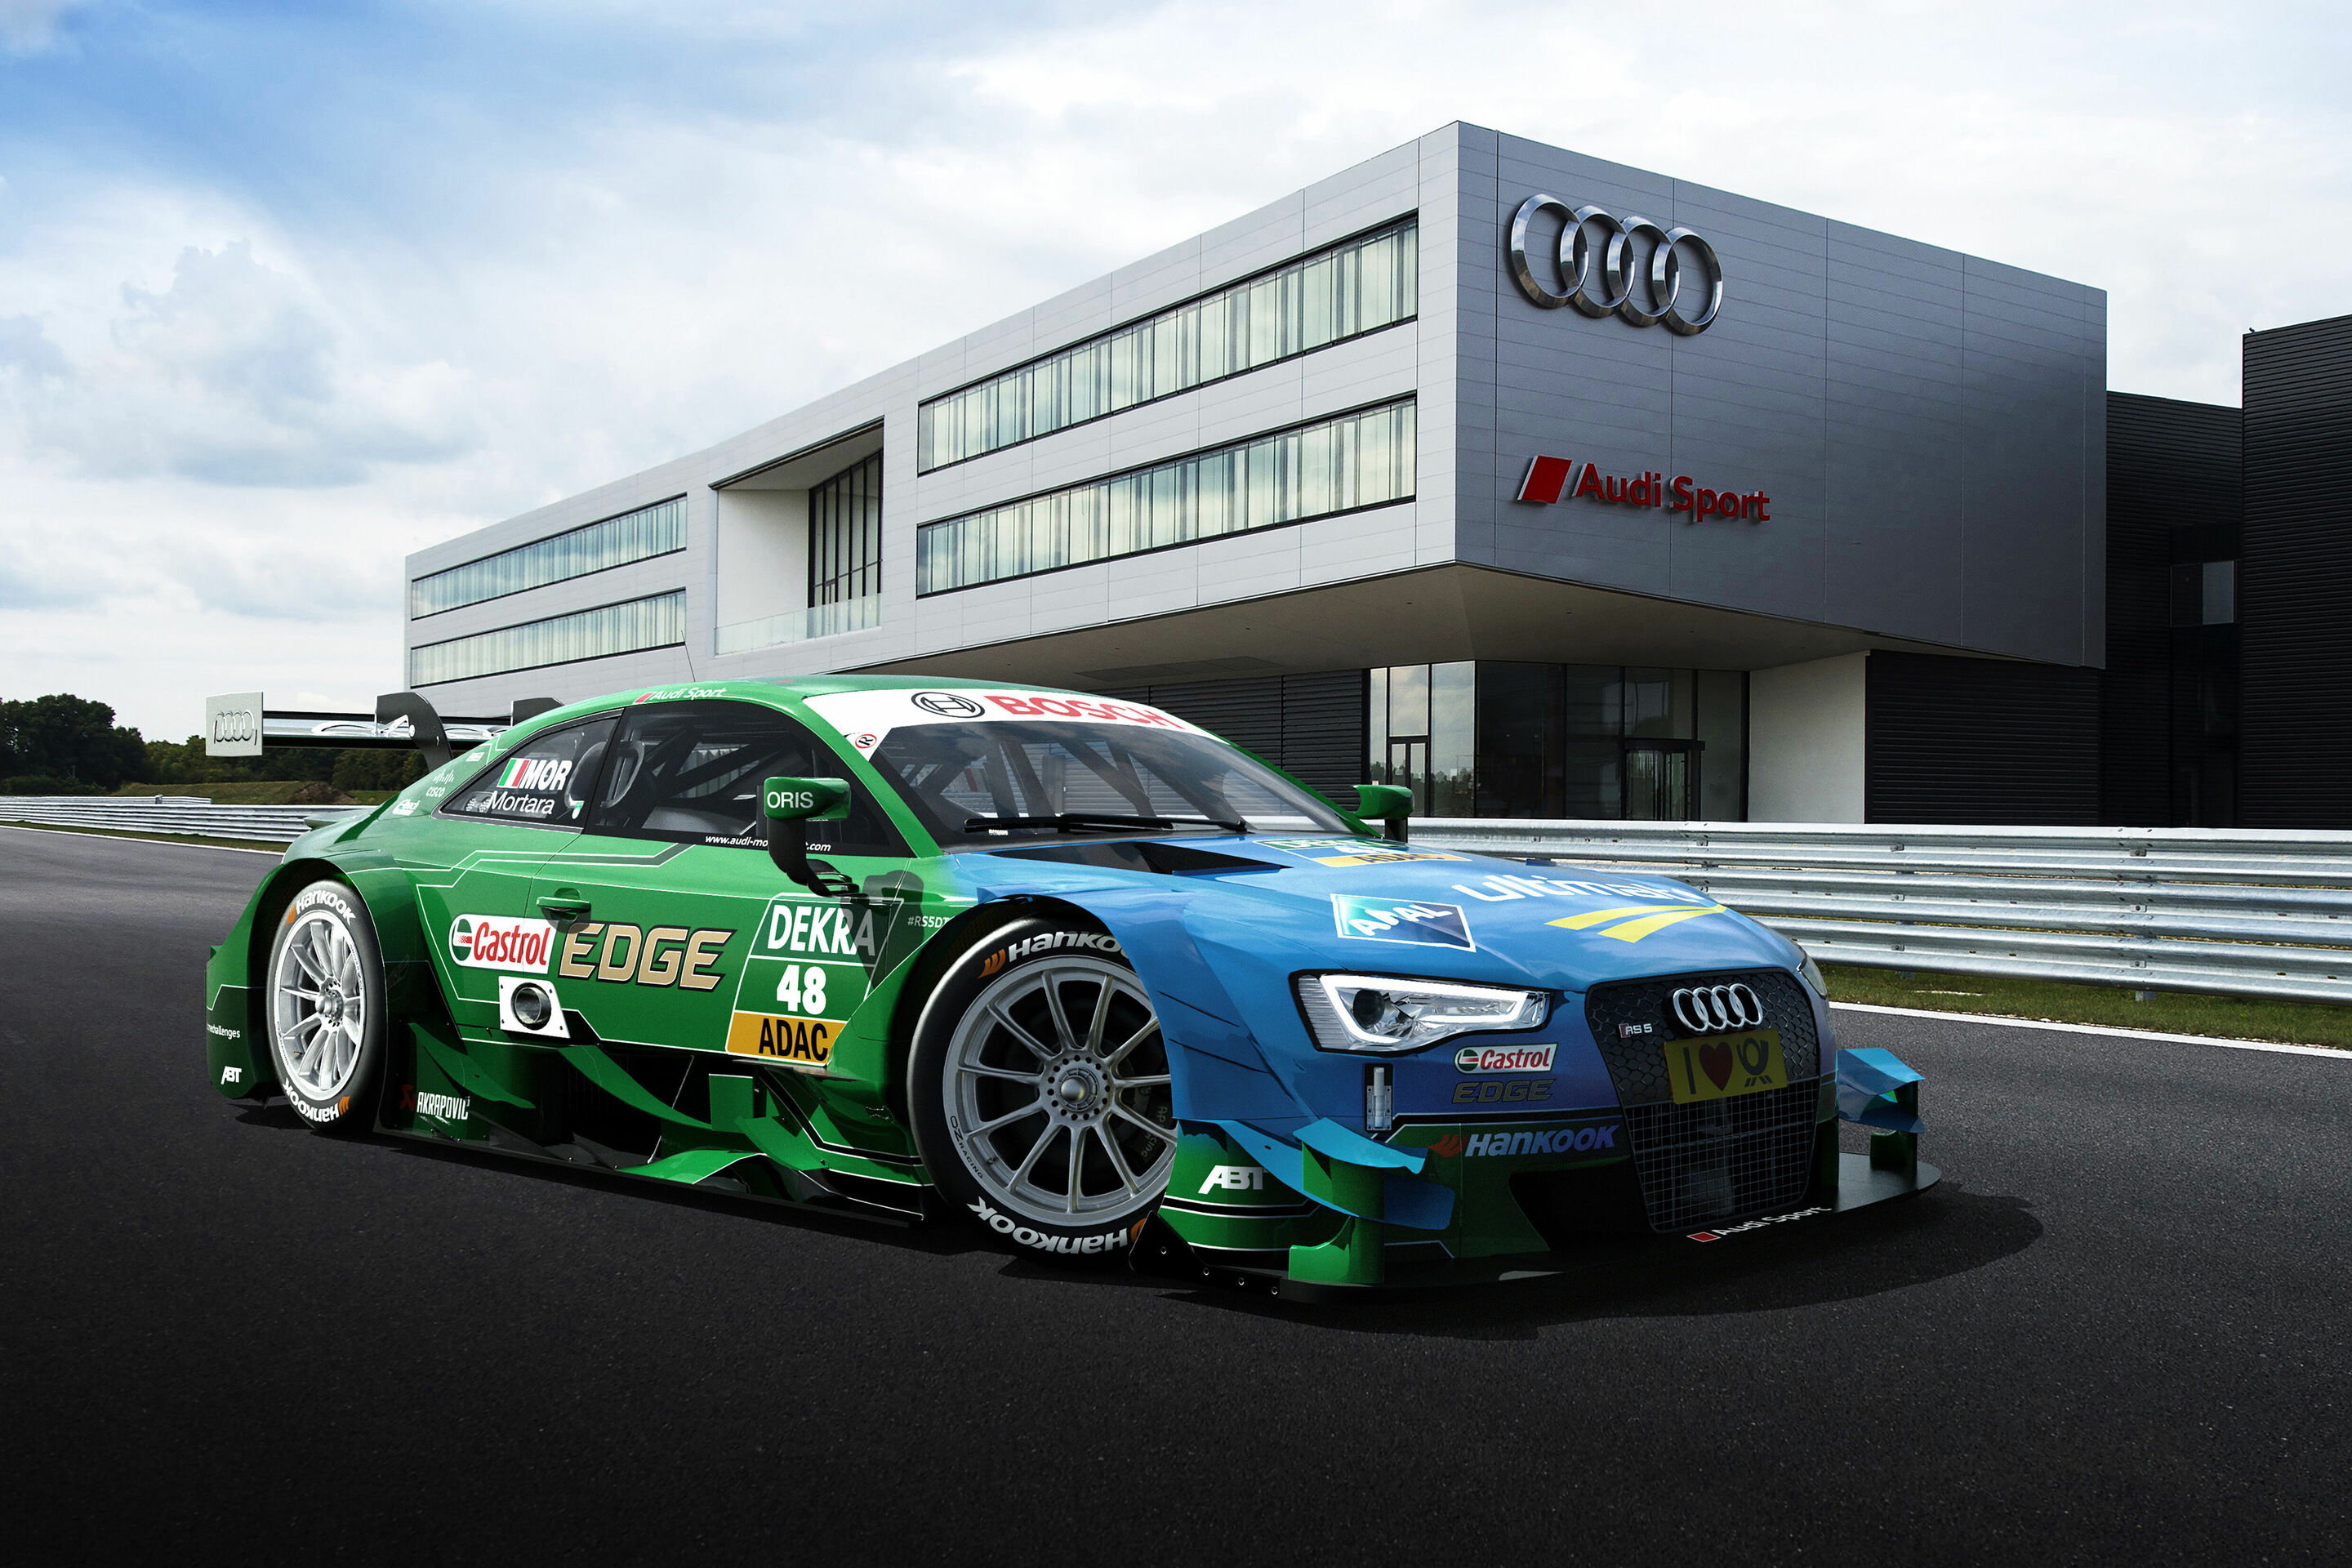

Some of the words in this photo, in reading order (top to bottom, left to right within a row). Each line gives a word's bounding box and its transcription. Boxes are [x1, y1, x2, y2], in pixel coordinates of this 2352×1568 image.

[1571, 462, 1662, 508] Audi
[1670, 474, 1771, 523] Sport
[650, 688, 686, 701] Audi
[684, 688, 726, 701] Sport
[983, 694, 1187, 730] BOSCH
[519, 760, 573, 791] MOR
[490, 791, 555, 815] Mortara
[767, 791, 814, 808] ORIS
[767, 903, 877, 957] DEKRA
[472, 921, 552, 967] Castrol
[558, 921, 738, 991] EDGE
[776, 964, 827, 1015] 48
[759, 1017, 830, 1062] ADAC
[1478, 1046, 1552, 1072] Castrol
[220, 1066, 243, 1085] ABT
[1451, 1077, 1557, 1105] EDGE
[1197, 1165, 1267, 1195] ABT
[1711, 1220, 1771, 1236] Audi
[1761, 1206, 1833, 1223] Sport
